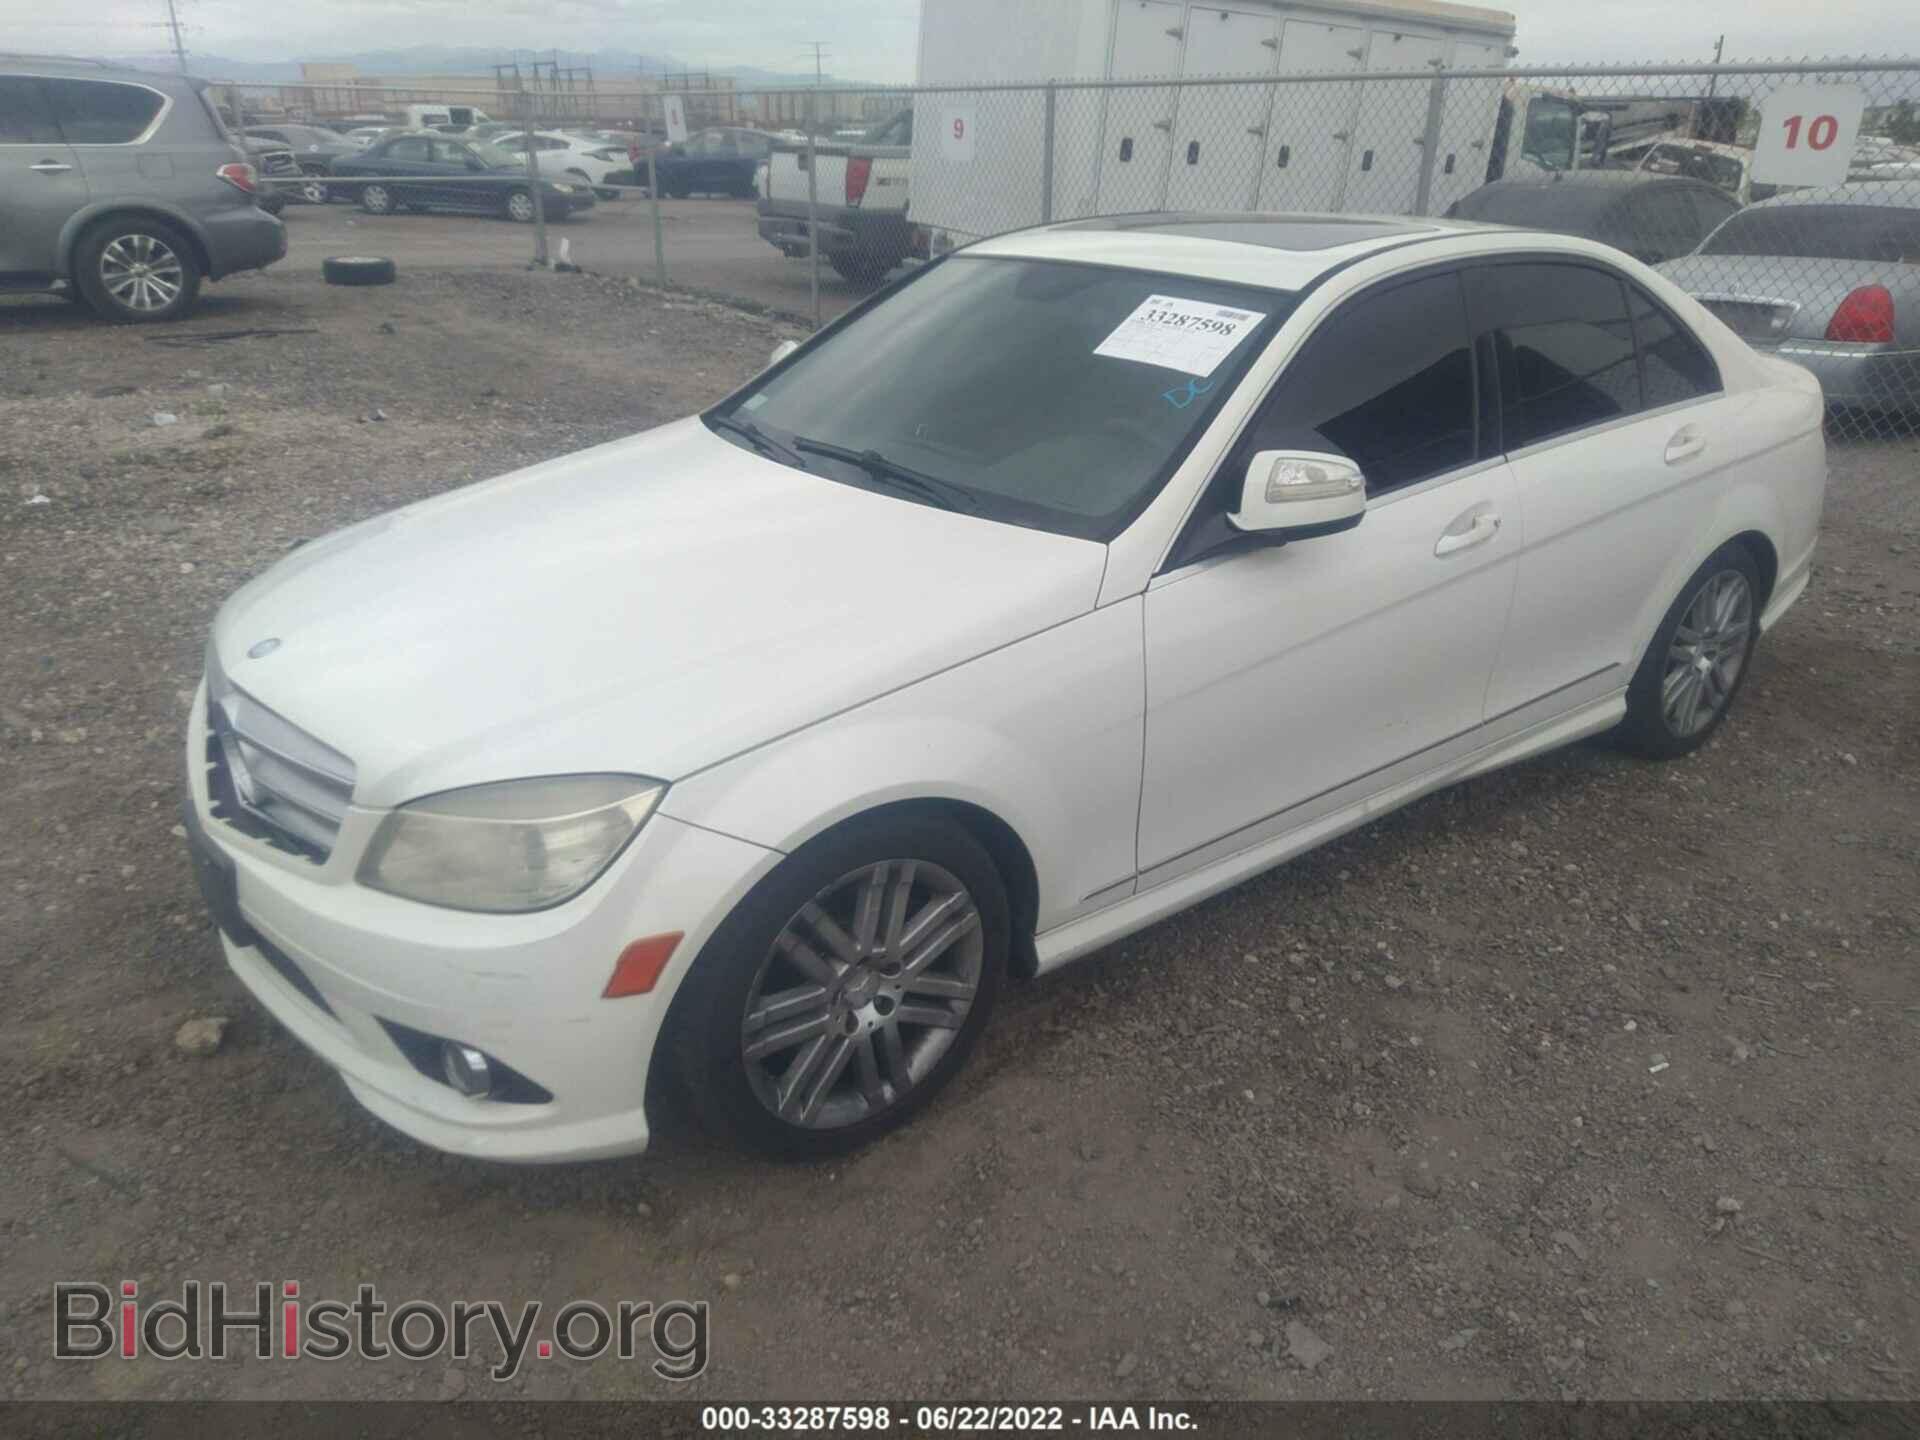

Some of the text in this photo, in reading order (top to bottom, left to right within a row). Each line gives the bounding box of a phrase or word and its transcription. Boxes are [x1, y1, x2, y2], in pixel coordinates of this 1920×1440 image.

[953, 118, 965, 140] 9
[1783, 115, 1839, 151] 10
[1140, 309, 1237, 336] 33287598
